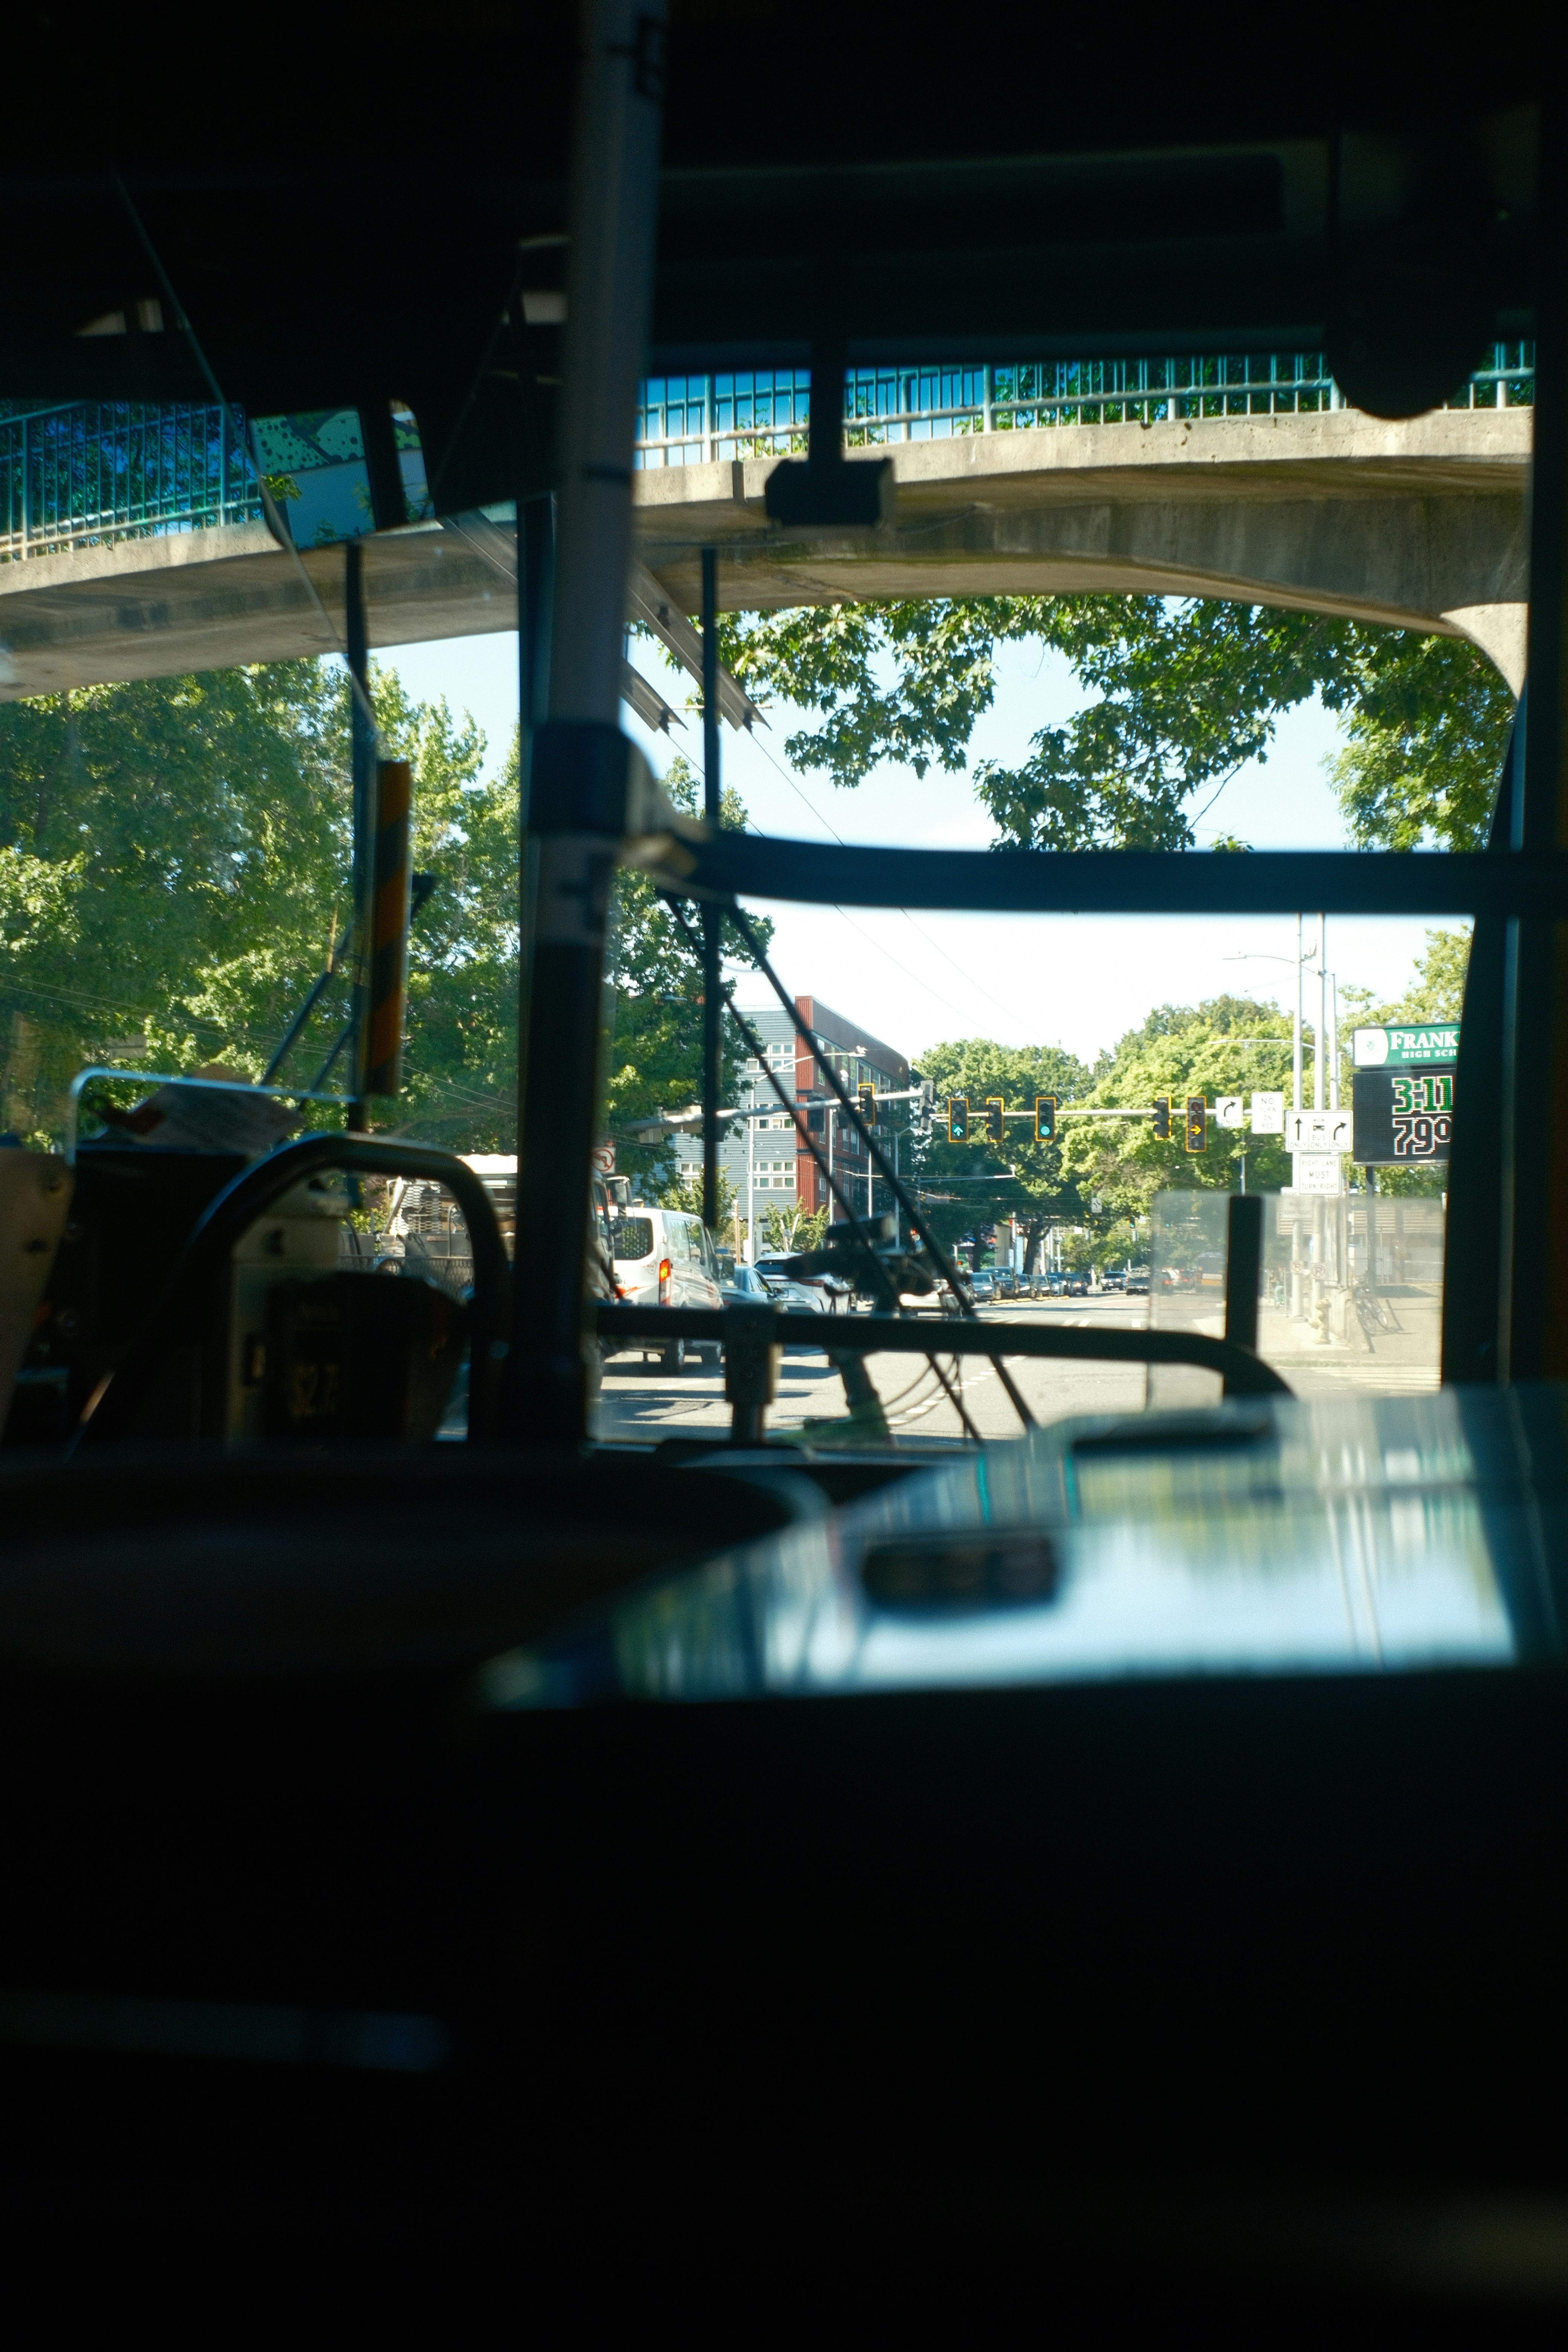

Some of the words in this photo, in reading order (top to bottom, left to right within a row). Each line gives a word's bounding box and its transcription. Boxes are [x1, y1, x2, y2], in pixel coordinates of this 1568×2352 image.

[1390, 1031, 1460, 1050] FRANK
[1401, 1050, 1431, 1059] HIGH
[1392, 1075, 1454, 1115] 3:11
